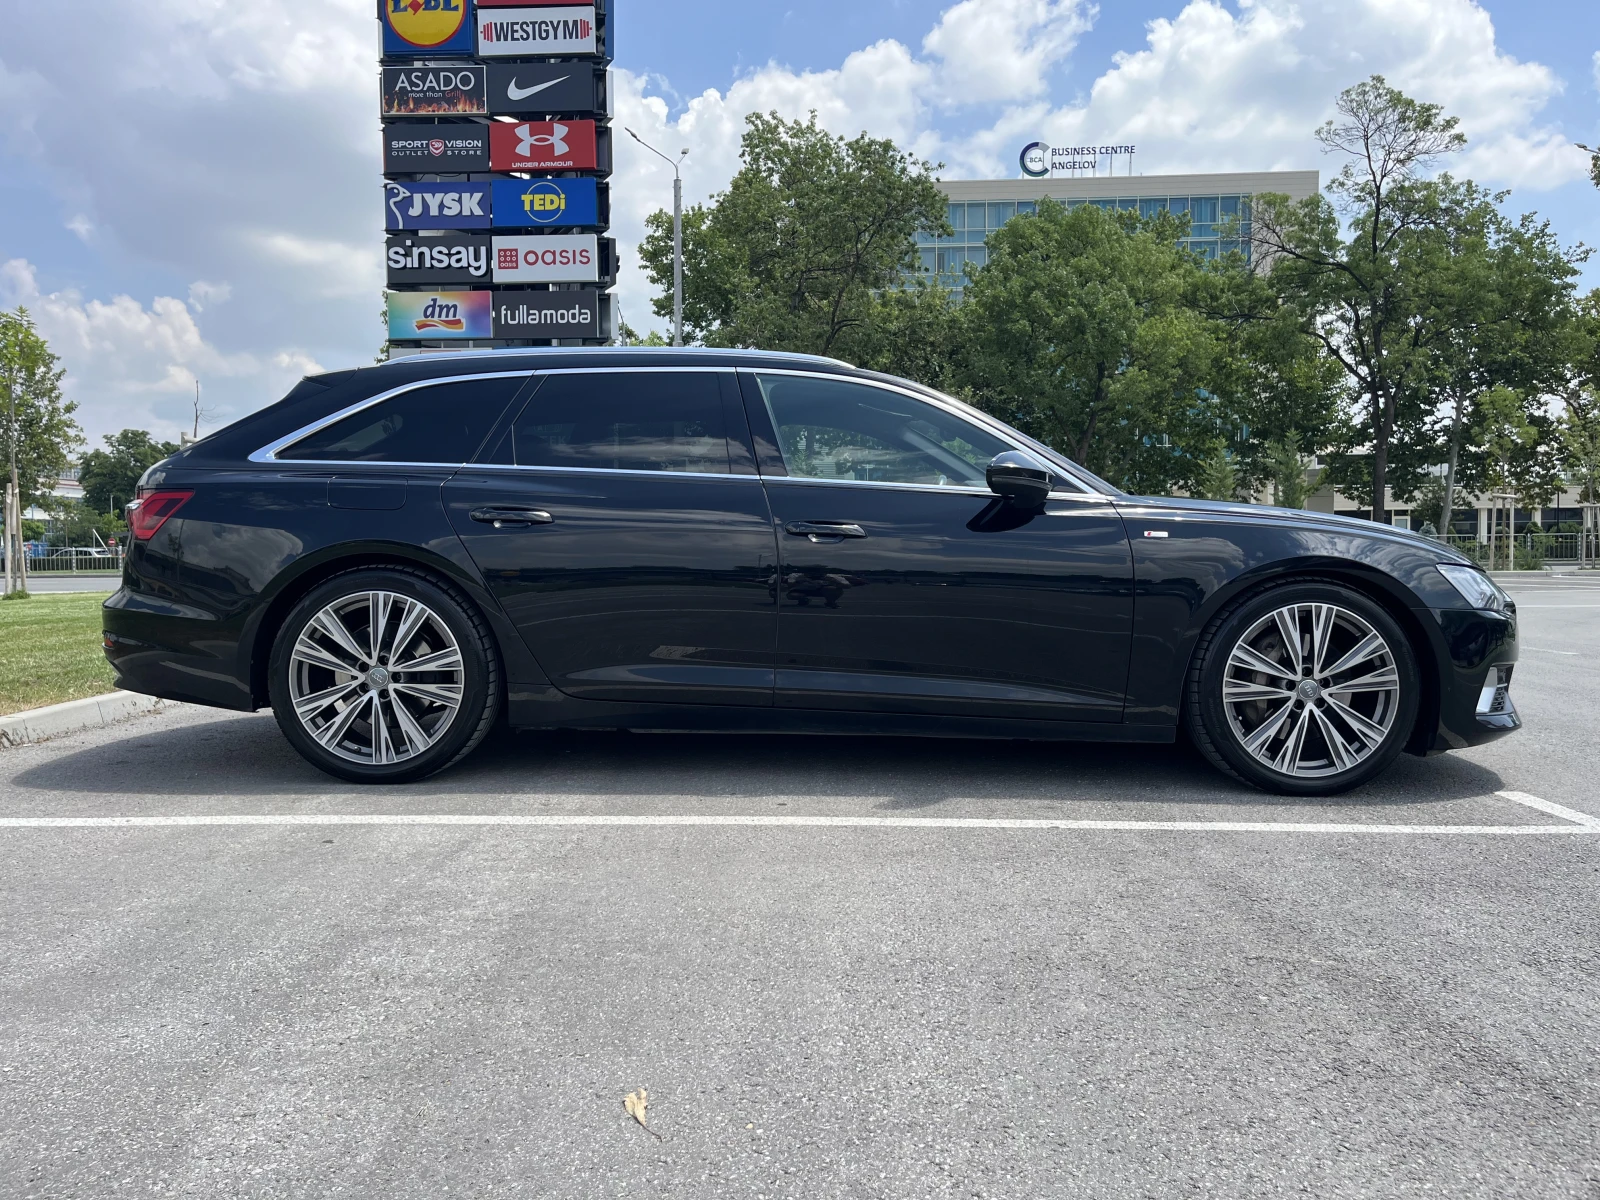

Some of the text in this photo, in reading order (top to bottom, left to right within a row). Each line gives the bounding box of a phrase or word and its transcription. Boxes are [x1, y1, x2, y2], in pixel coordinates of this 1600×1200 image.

[494, 19, 579, 42] WESTGYM
[395, 71, 475, 91] ASADO
[391, 140, 482, 148] SPORT VISION
[1051, 145, 1136, 156] BUSINESS CENTRE
[1051, 160, 1096, 170] ANGELOV
[408, 192, 484, 217] JYSK
[388, 240, 487, 276] sinsay
[523, 249, 591, 266] oasis
[422, 298, 458, 318] dm
[501, 305, 591, 324] fullamoda
